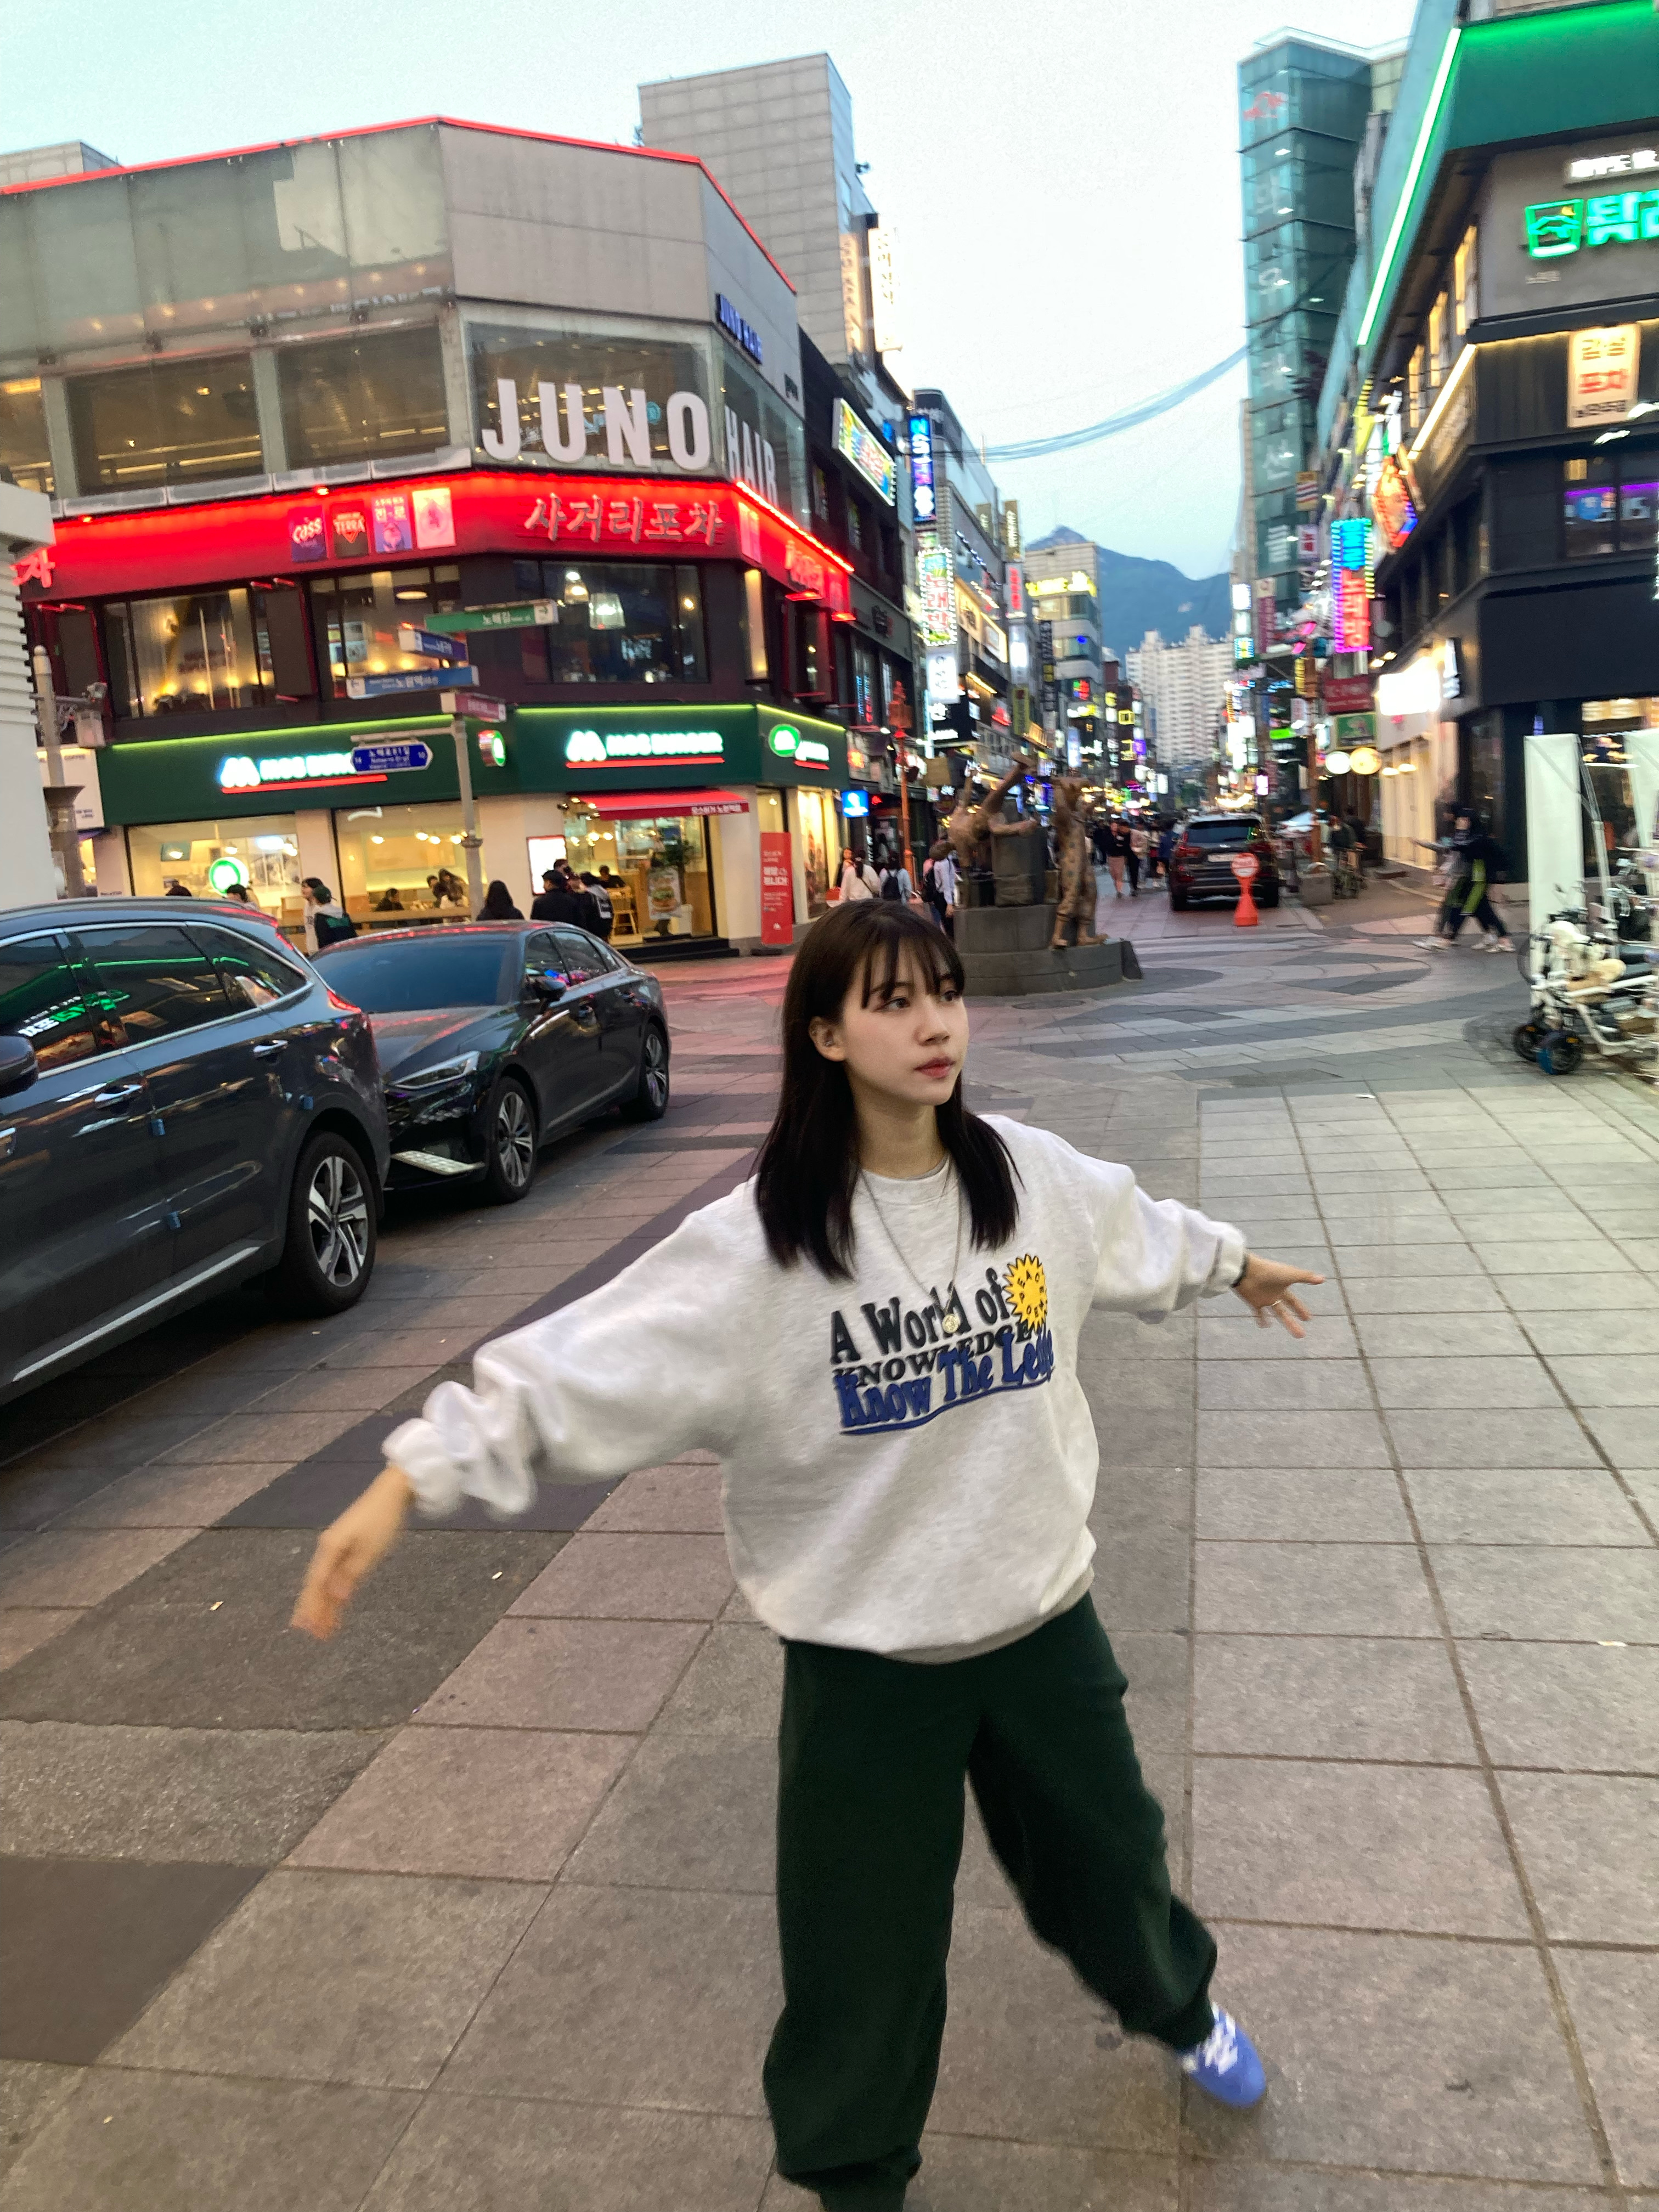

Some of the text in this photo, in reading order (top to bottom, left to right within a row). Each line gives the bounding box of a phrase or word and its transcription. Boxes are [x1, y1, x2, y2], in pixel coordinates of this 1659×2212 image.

[482, 378, 711, 471] JUNO
[724, 404, 778, 510] HAIR
[523, 492, 725, 546] 사거리포차
[831, 1268, 1011, 1365] A World of
[833, 1373, 932, 1427] Know
[938, 1344, 995, 1402] The
